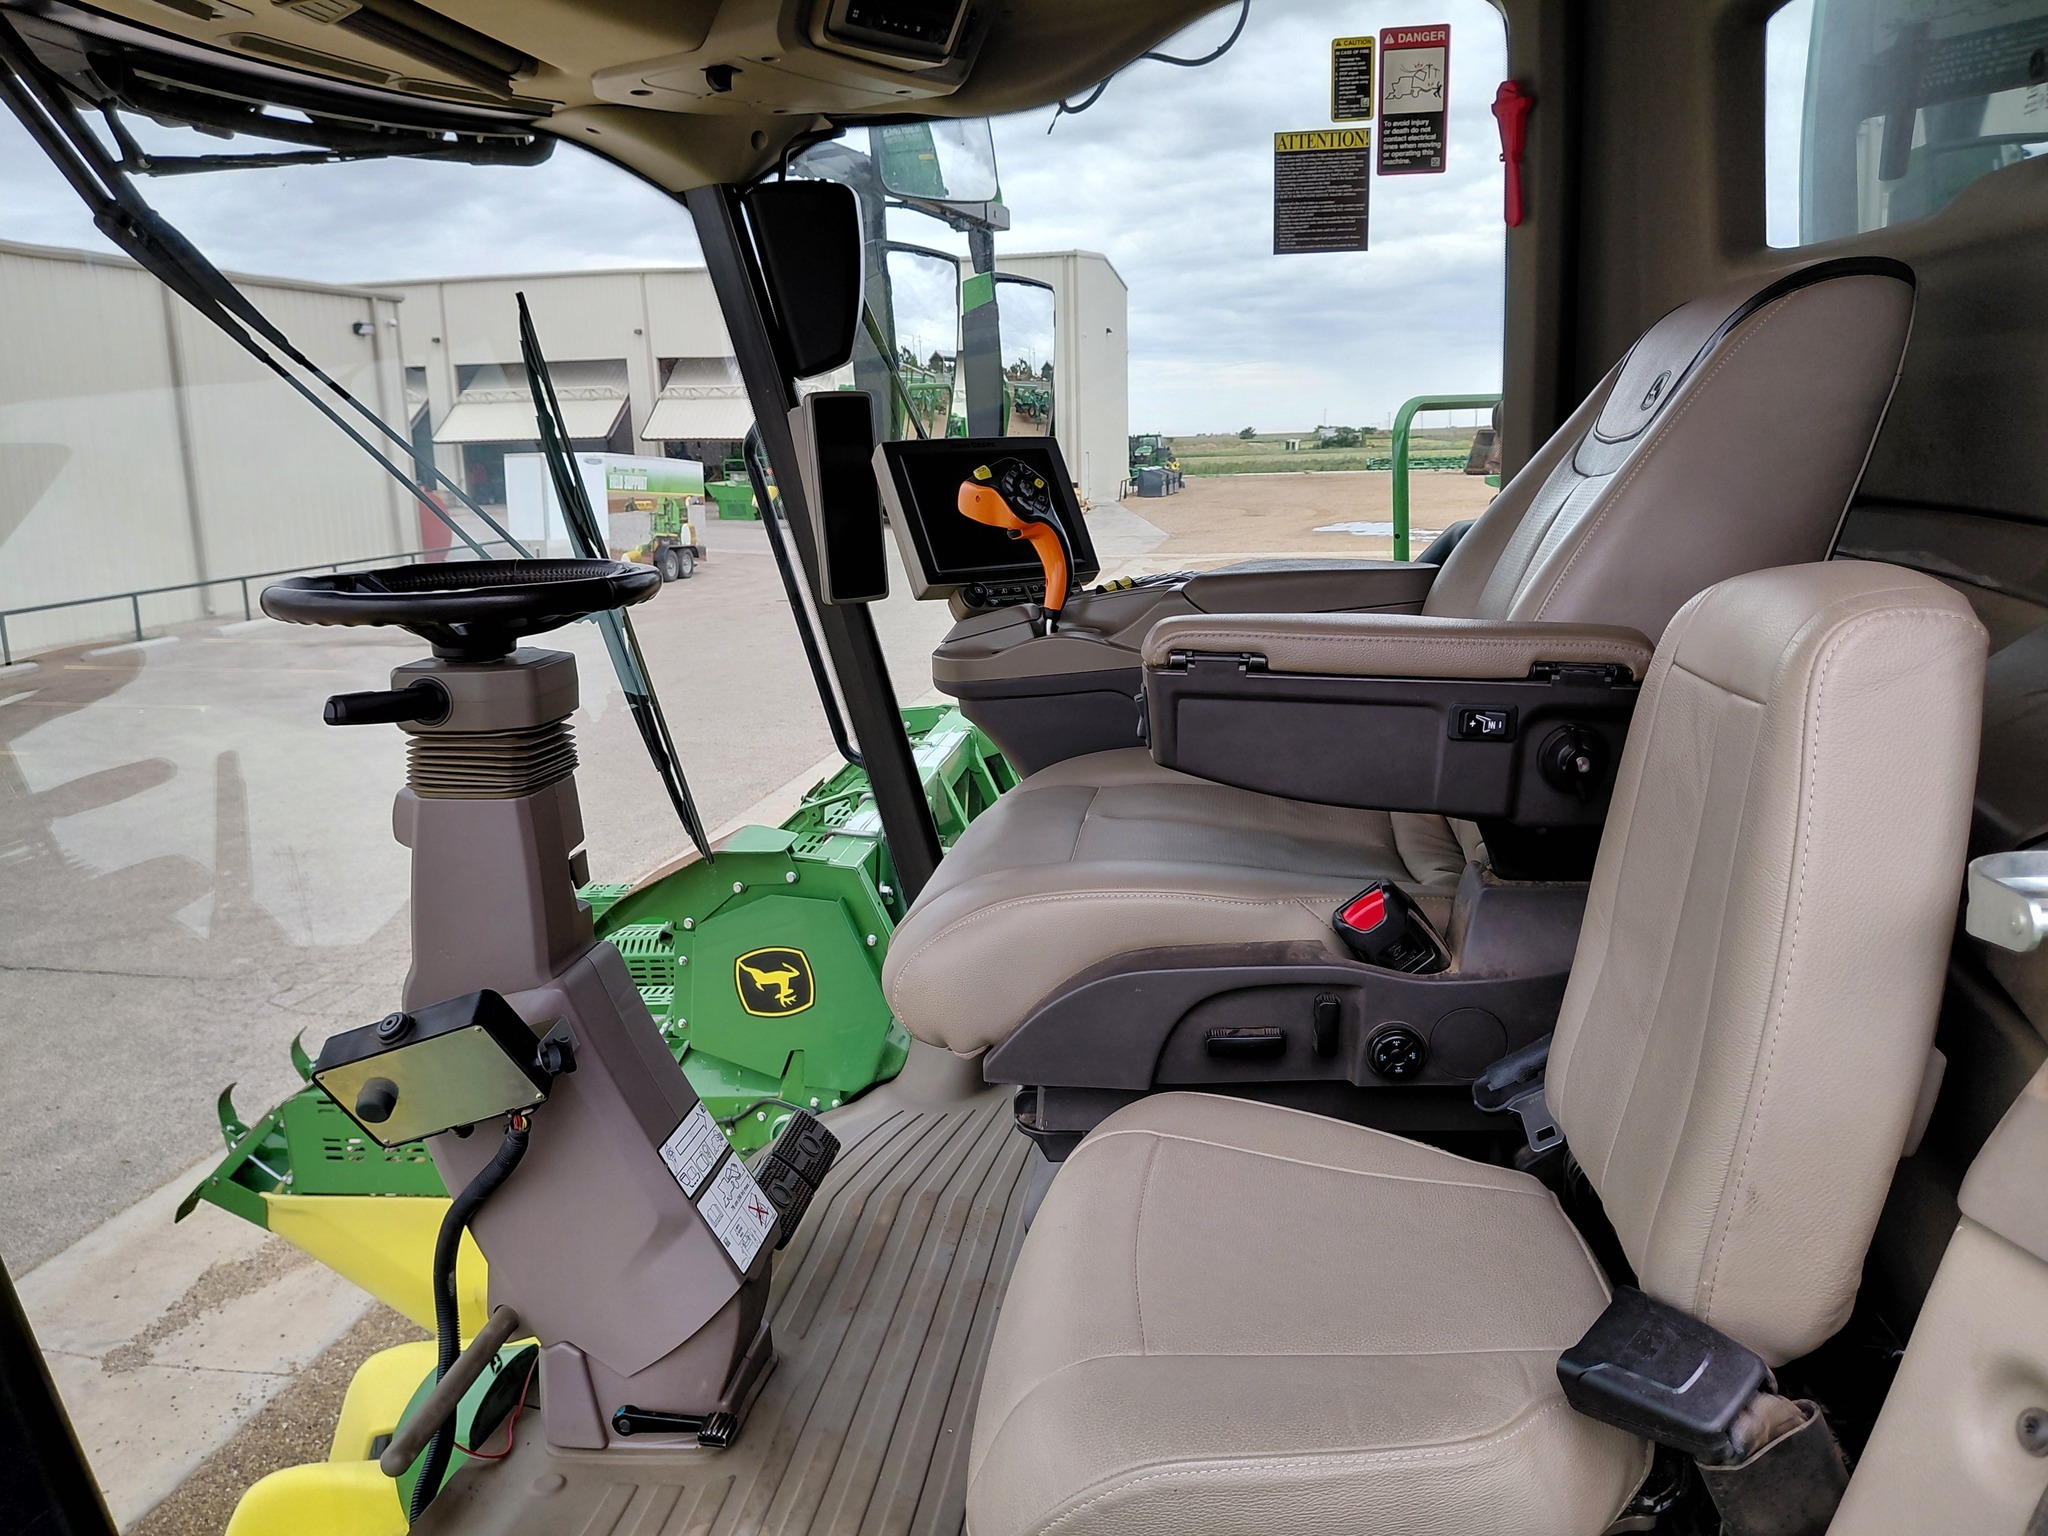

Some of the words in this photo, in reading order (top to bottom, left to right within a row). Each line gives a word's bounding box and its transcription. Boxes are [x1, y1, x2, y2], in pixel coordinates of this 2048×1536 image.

[1398, 31, 1445, 43] DANGER
[1392, 119, 1410, 127] avoid
[1410, 119, 1429, 127] injury
[1277, 130, 1369, 150] ATTENTION!
[1407, 133, 1436, 141] electrical
[1417, 141, 1441, 149] moving
[1391, 150, 1421, 158] operating
[624, 475, 648, 491] SUPPORT
